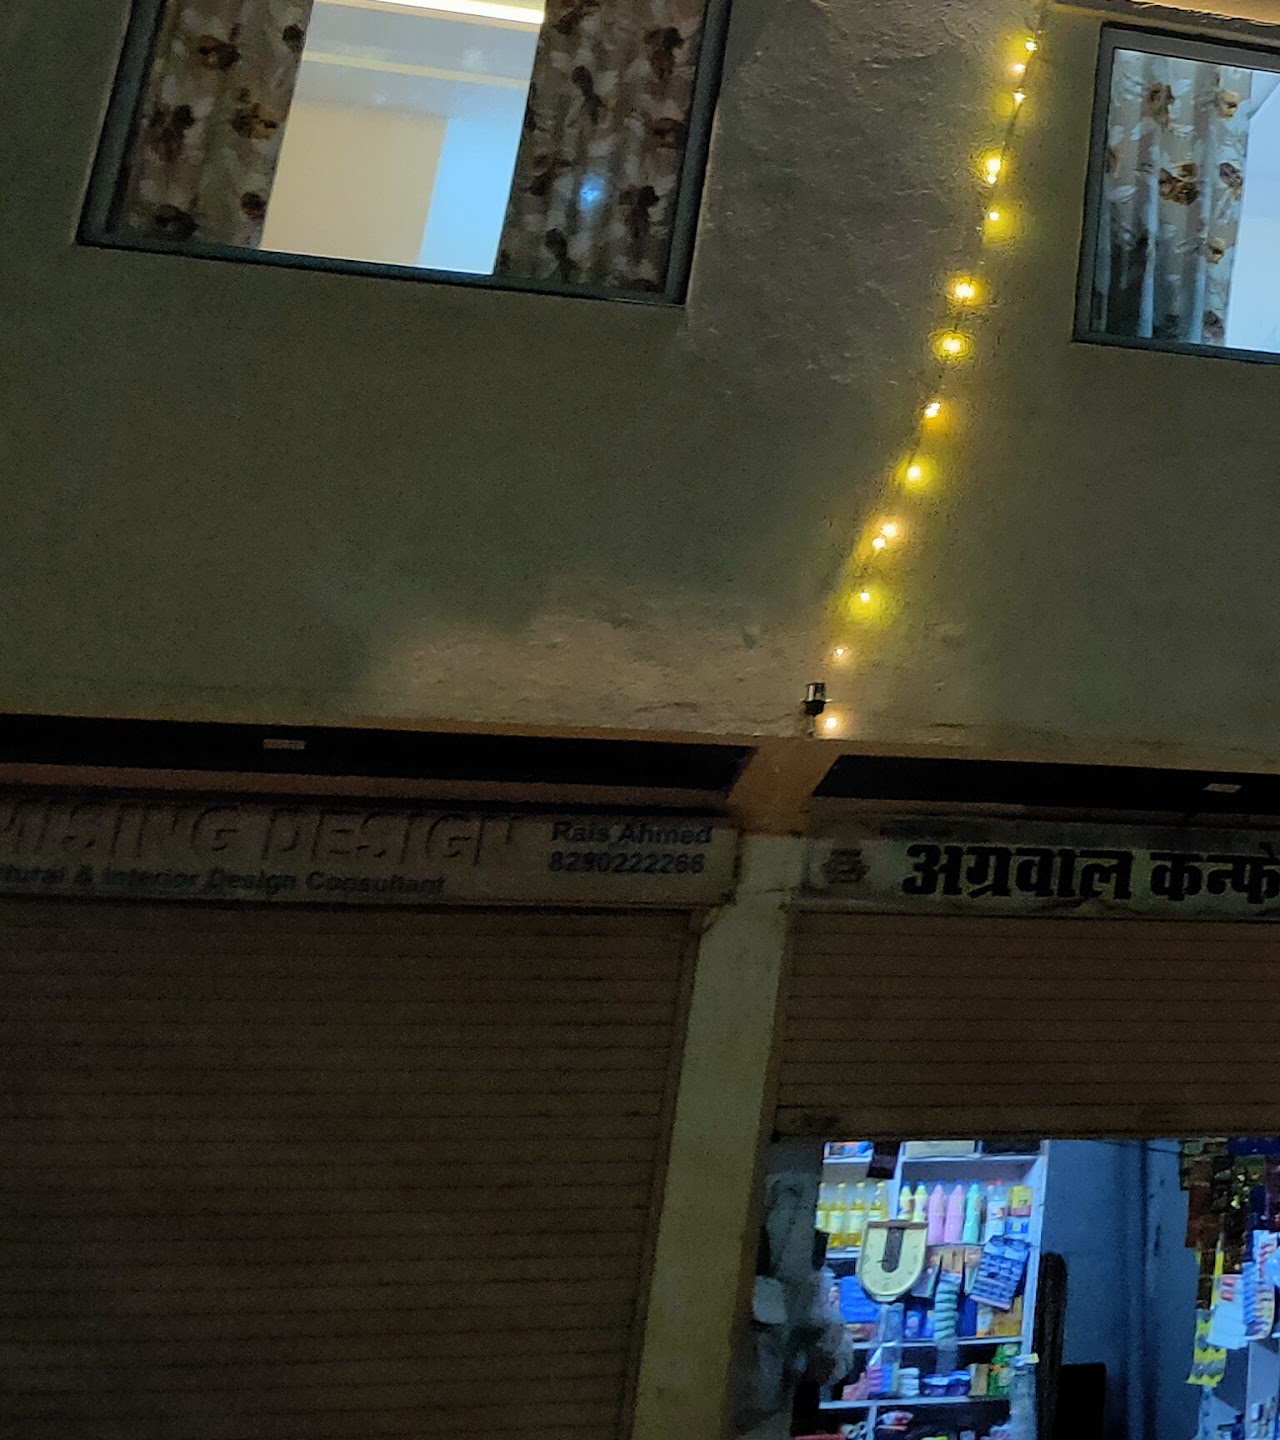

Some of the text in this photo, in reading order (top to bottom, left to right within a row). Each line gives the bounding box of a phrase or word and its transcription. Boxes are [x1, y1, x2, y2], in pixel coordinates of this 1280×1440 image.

[551, 821, 713, 846] Rais Ahmed
[206, 867, 297, 894] Design
[305, 870, 444, 894] Consultant
[902, 841, 1132, 900] अग्रवाल
